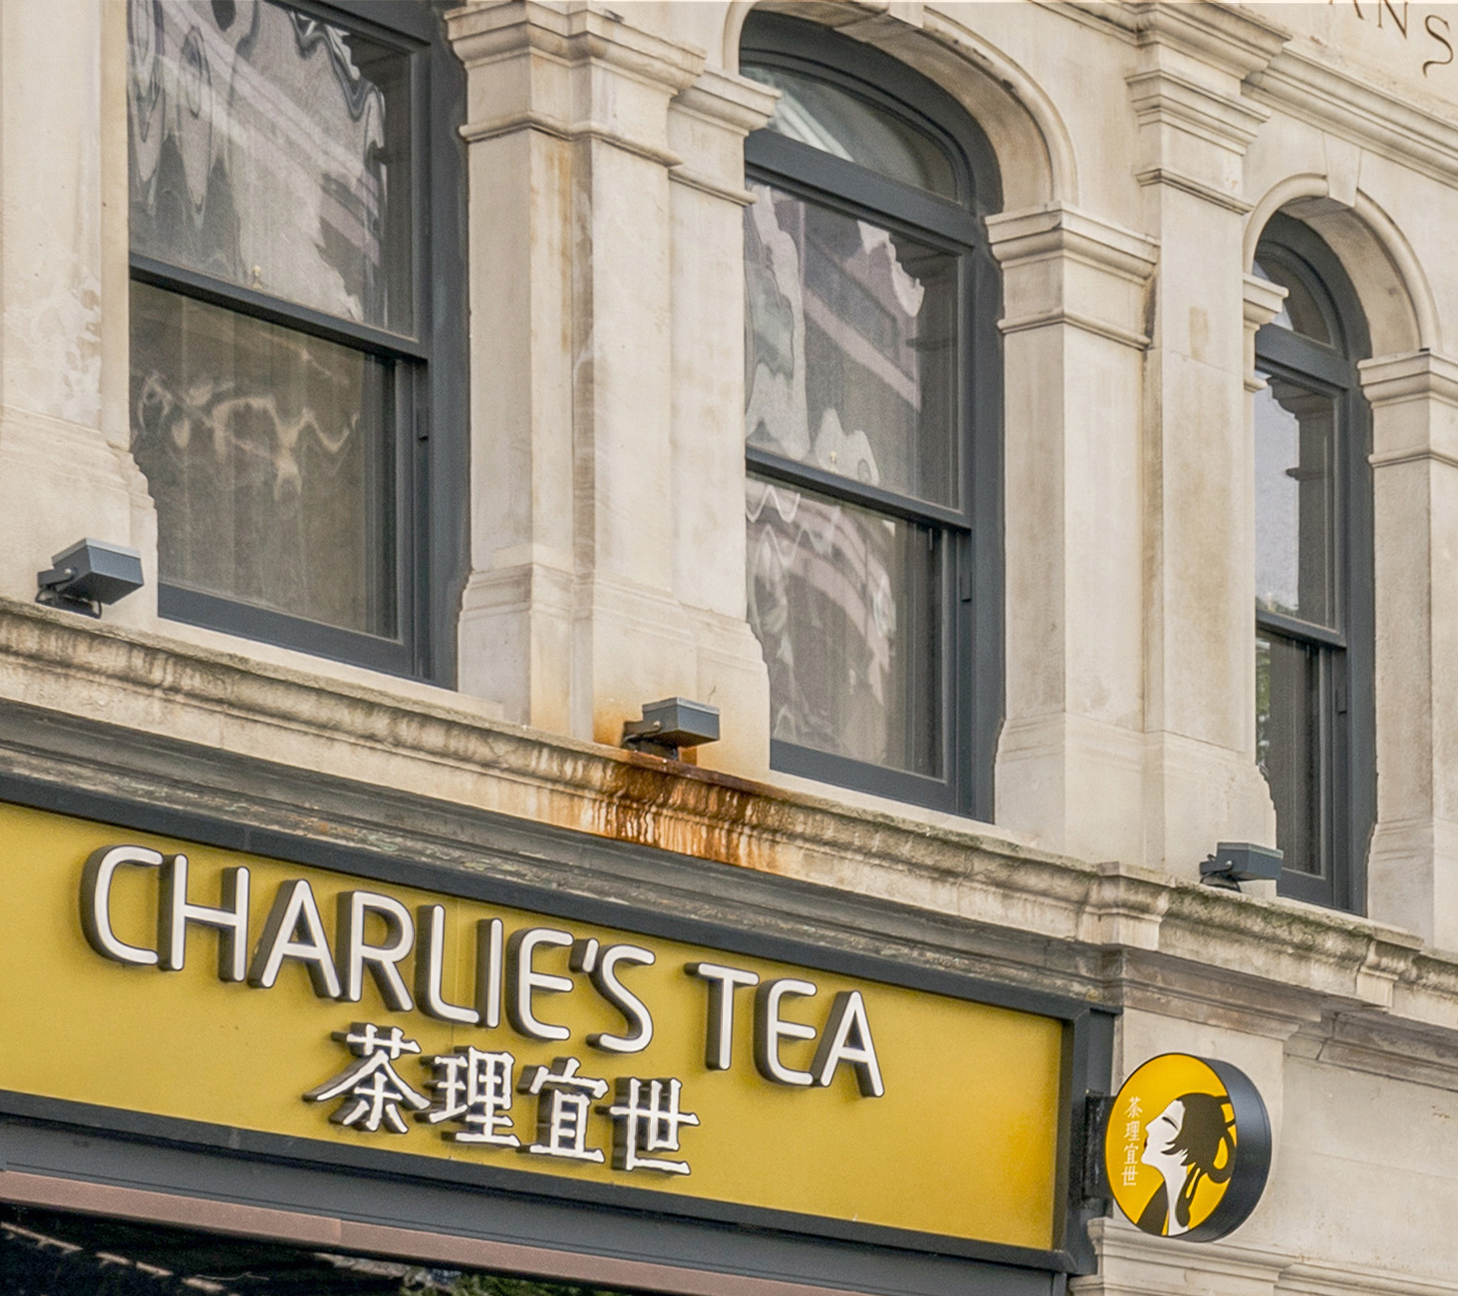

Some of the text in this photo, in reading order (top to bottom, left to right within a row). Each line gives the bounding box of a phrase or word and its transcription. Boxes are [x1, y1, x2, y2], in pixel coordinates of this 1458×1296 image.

[81, 842, 885, 1098] CHARLIE'S TEA
[303, 1022, 702, 1176] 茶理宜世
[1121, 1096, 1143, 1187] 茶理宜世
